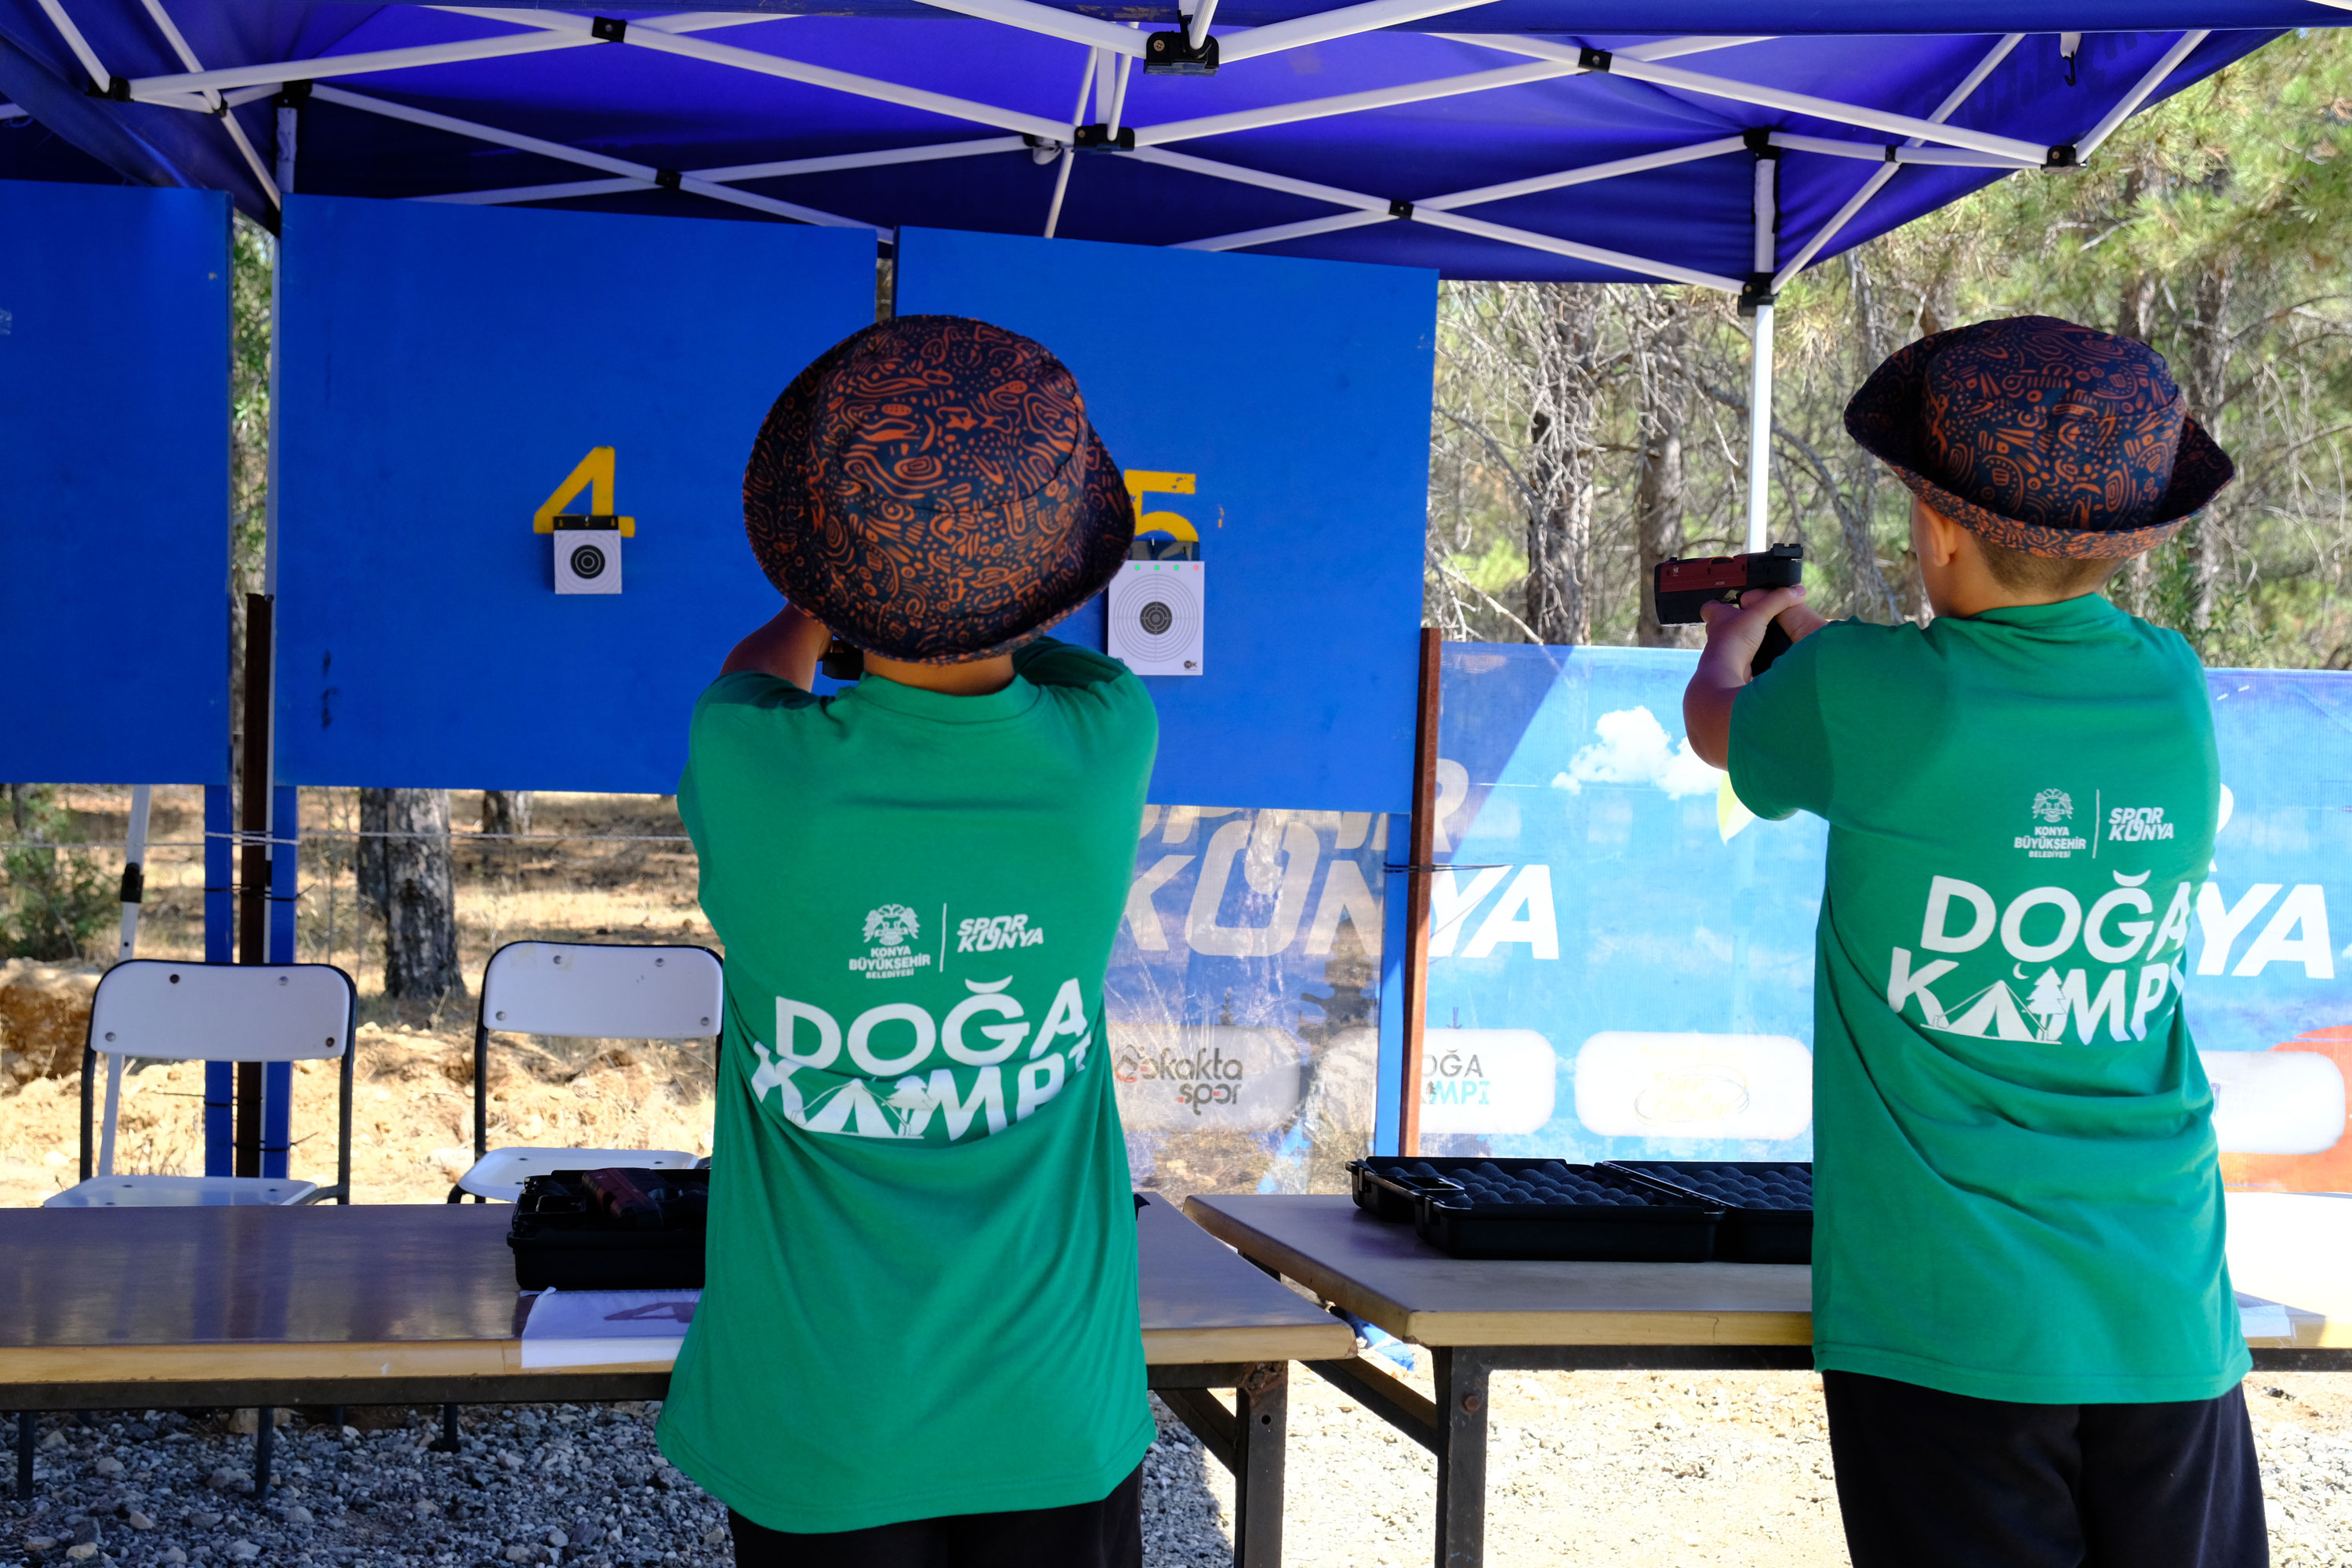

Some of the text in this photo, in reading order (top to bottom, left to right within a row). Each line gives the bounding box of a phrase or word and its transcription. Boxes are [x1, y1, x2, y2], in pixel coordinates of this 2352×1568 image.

[533, 445, 635, 539] 4
[1123, 469, 1199, 543] 5
[2108, 808, 2164, 825] SPOR
[2034, 826, 2070, 836] KONYA
[2108, 819, 2174, 841] KONYA
[2013, 835, 2087, 850] BÜYÜKŞEHİR
[2028, 850, 2071, 858] BELEDİYESİ
[956, 914, 1029, 939] SPOR
[1921, 869, 2190, 964] DOĞA
[870, 945, 911, 958] KONYA
[957, 927, 1044, 953] KONYA
[848, 953, 931, 971] BÜYÜKŞEHİR
[866, 968, 914, 979] BELEDİYESİ
[776, 975, 1087, 1076] DOĞA
[1422, 1048, 1484, 1078] OĞA
[1177, 1083, 1241, 1116] spor
